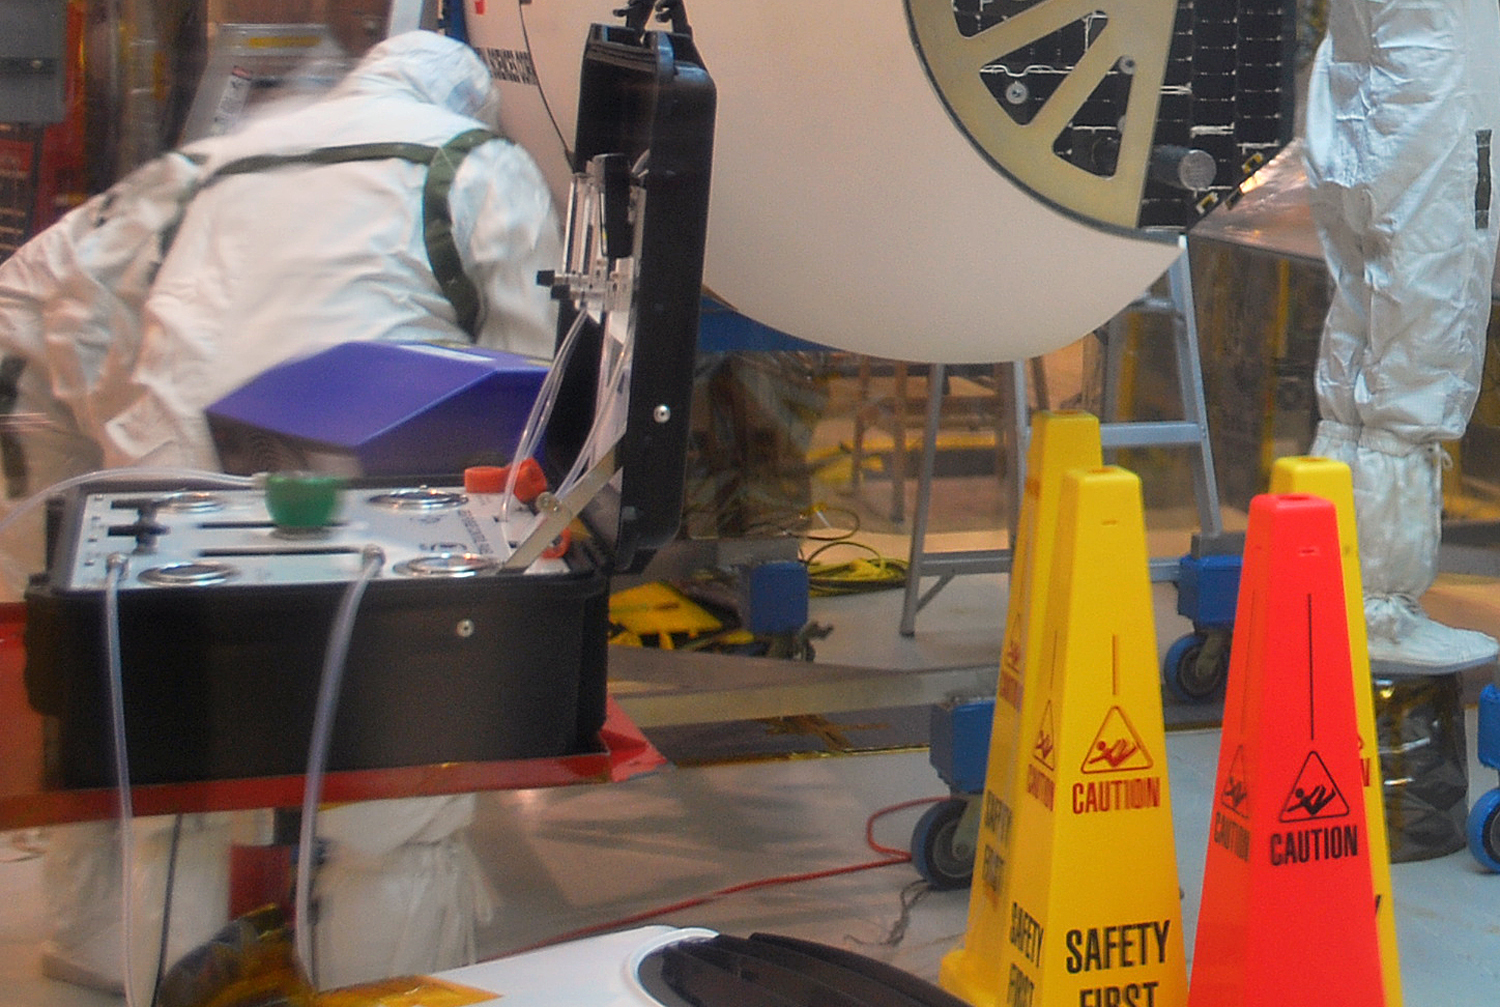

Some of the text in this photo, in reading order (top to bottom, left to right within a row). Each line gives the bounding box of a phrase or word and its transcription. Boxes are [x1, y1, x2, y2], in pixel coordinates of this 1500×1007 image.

[1072, 776, 1160, 815] CAUTION
[1269, 825, 1358, 866] CAUTION
[1009, 901, 1044, 969] SAFETY
[1066, 919, 1171, 974] SAFETY
